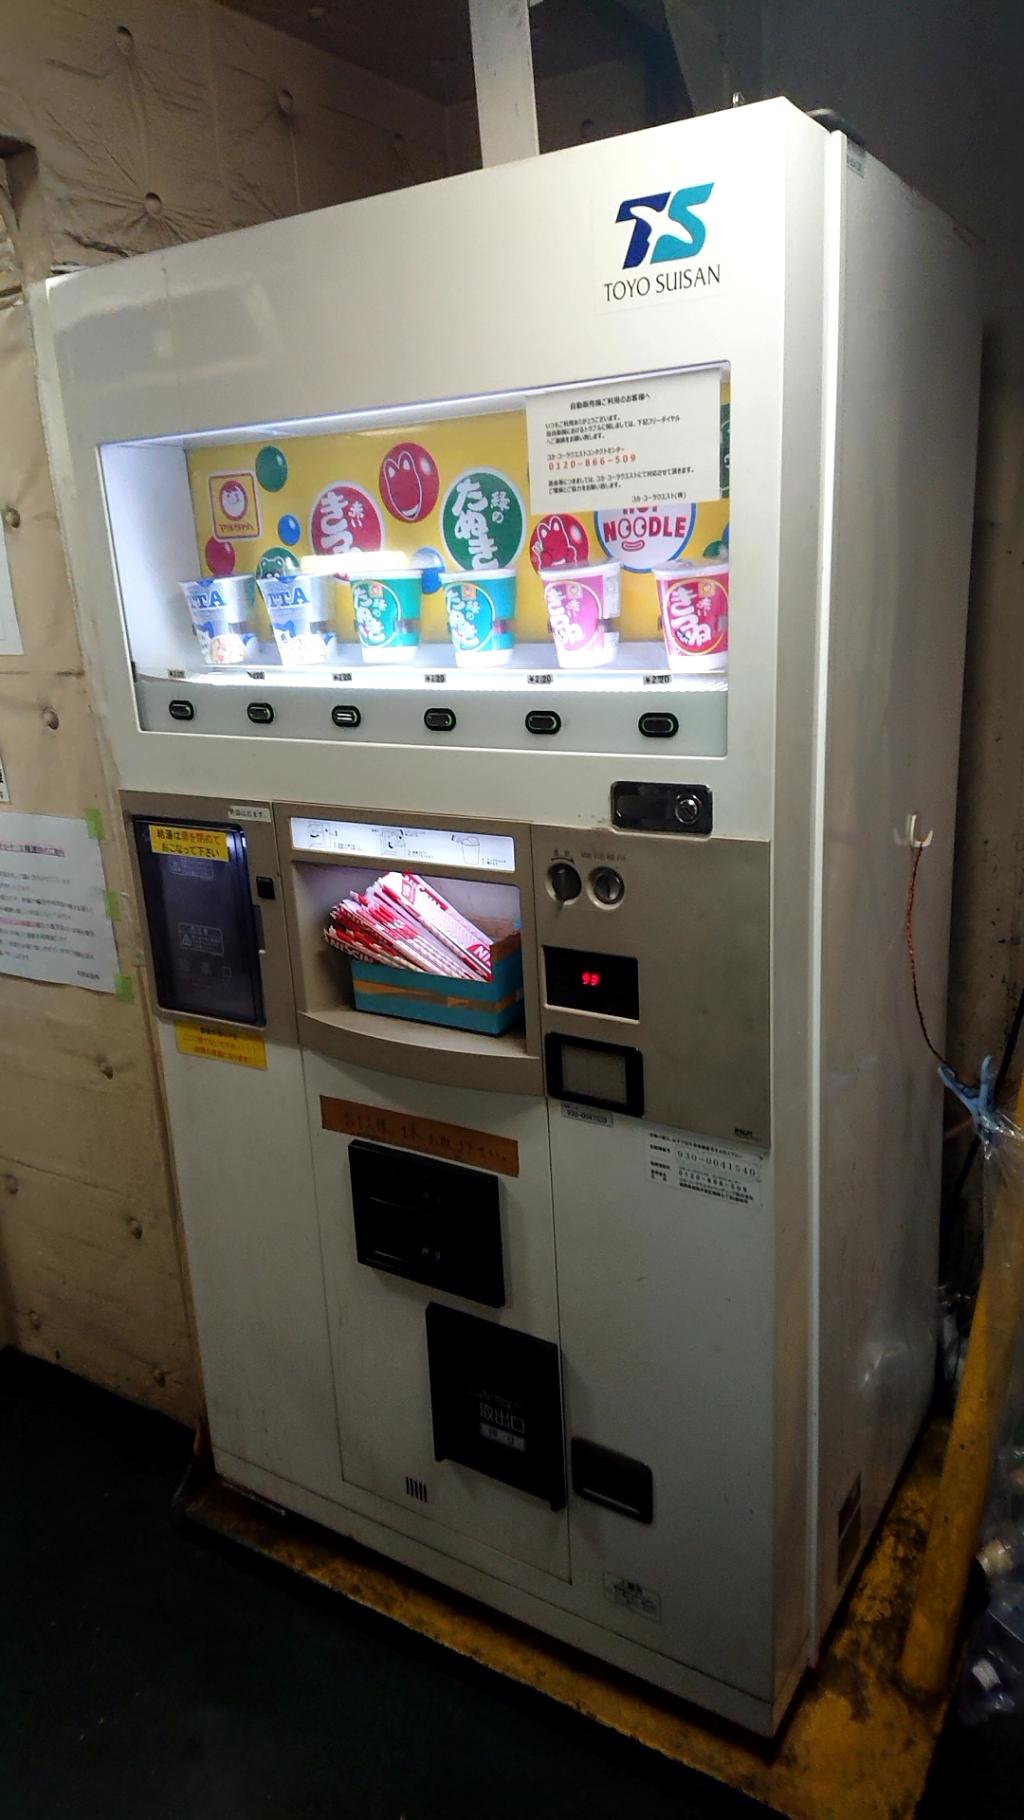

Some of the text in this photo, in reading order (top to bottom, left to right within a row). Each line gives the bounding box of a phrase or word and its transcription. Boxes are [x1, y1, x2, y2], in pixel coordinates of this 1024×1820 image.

[604, 264, 720, 302] TOYO SUISAN
[489, 490, 510, 524] 緑の
[603, 516, 686, 542] NOODLE
[670, 585, 712, 647] きつね
